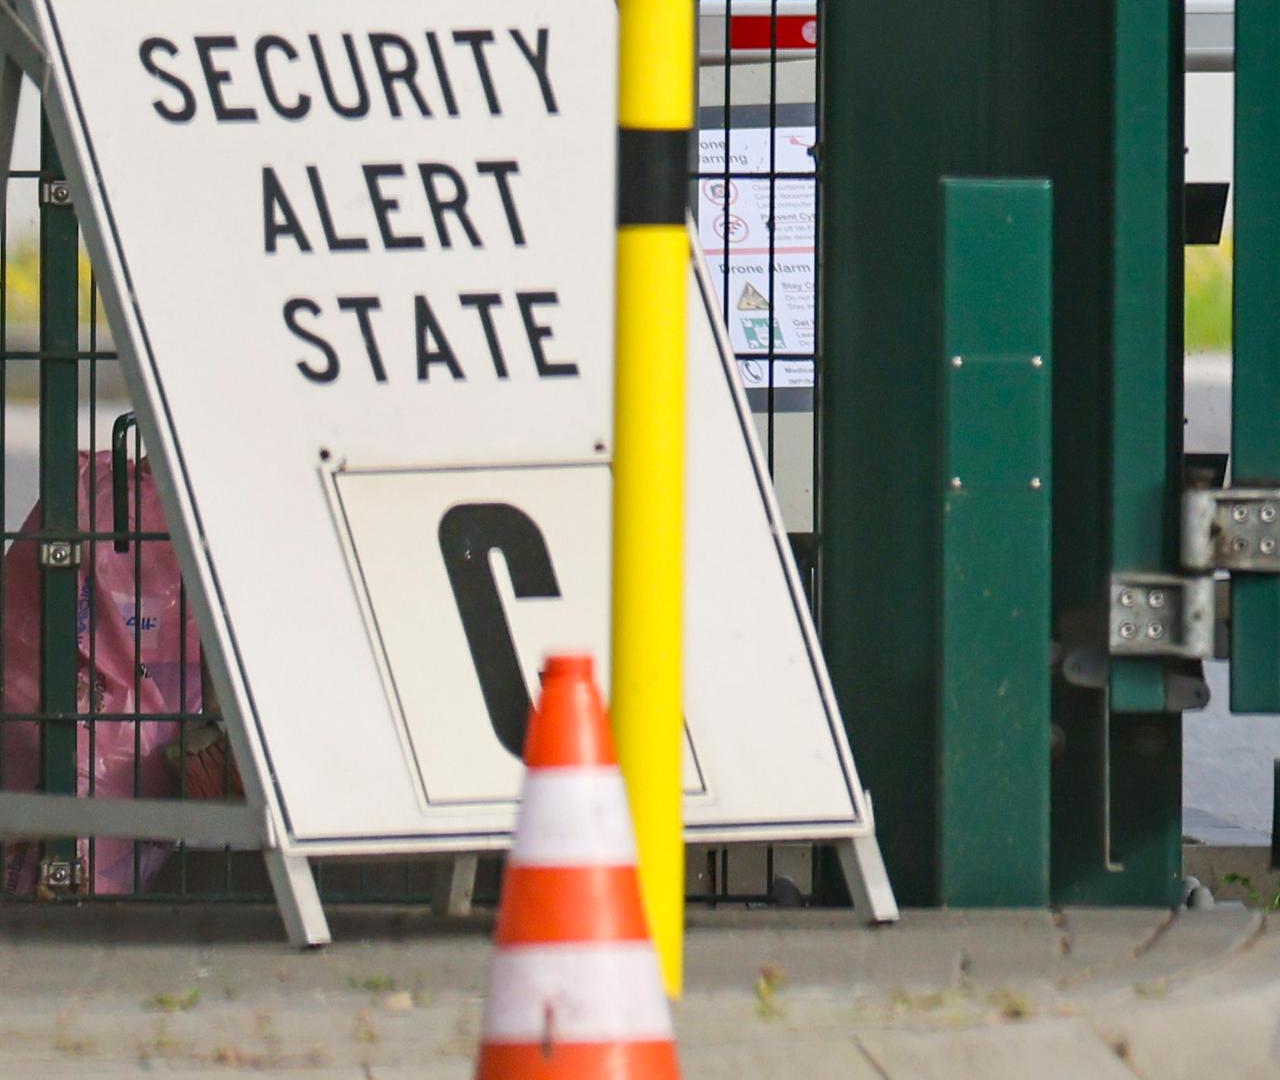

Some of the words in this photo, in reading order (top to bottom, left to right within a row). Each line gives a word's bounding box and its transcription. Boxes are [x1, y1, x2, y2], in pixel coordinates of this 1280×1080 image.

[139, 28, 559, 122] SECURITY
[262, 161, 526, 253] ALERT
[283, 291, 579, 383] STATE
[437, 503, 563, 760] C
